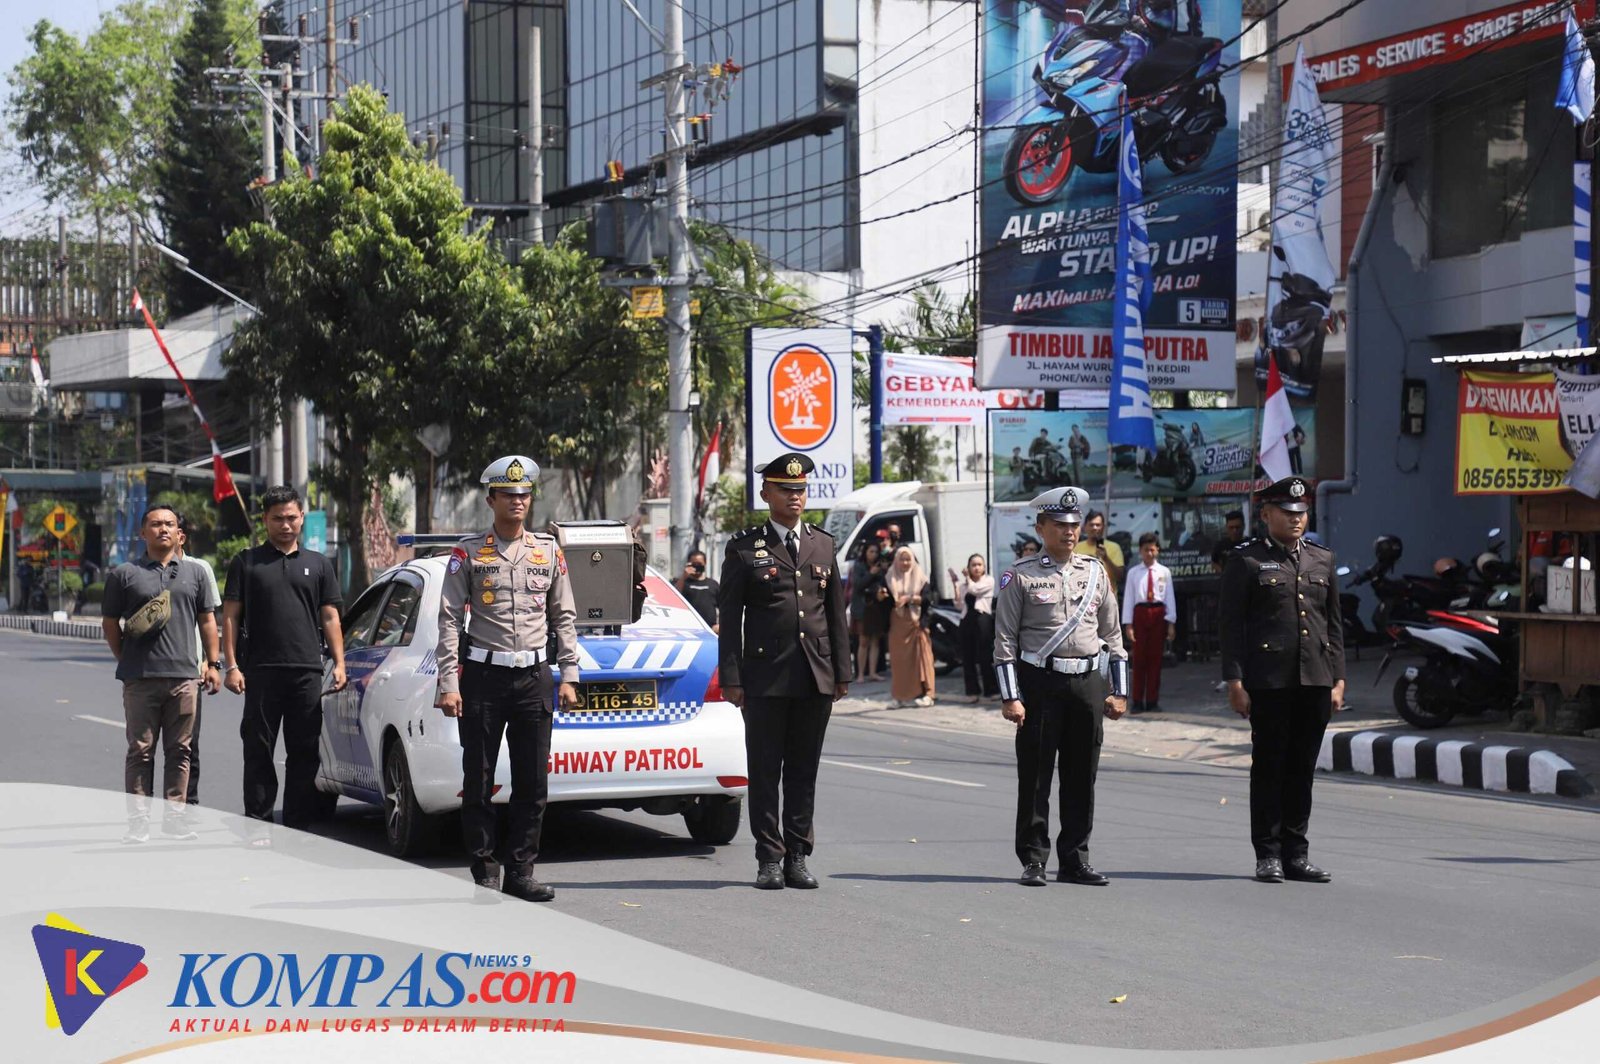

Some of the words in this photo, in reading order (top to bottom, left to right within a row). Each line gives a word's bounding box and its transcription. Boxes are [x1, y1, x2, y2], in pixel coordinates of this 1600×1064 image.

[1311, 54, 1360, 84] SALES
[1376, 32, 1446, 69] SERVICE
[1001, 207, 1092, 240] ALPHA
[1021, 231, 1110, 255] WAKTUNYA
[1166, 235, 1219, 266] UP!
[1185, 302, 1195, 322] 5
[1008, 333, 1087, 359] TIMBUL
[1144, 337, 1209, 361] PUTRA
[1026, 361, 1041, 370] JL.
[1043, 362, 1080, 371] HAYAM
[1083, 363, 1113, 372] WURU
[1157, 365, 1191, 374] KEDIRI
[1039, 374, 1098, 384] PHONE/WA
[887, 398, 986, 407] KEMERDEKAAN
[1204, 447, 1216, 466] 3
[1216, 448, 1251, 465] GRATIS
[526, 567, 549, 577] POLRI
[624, 747, 704, 772] PATROL
